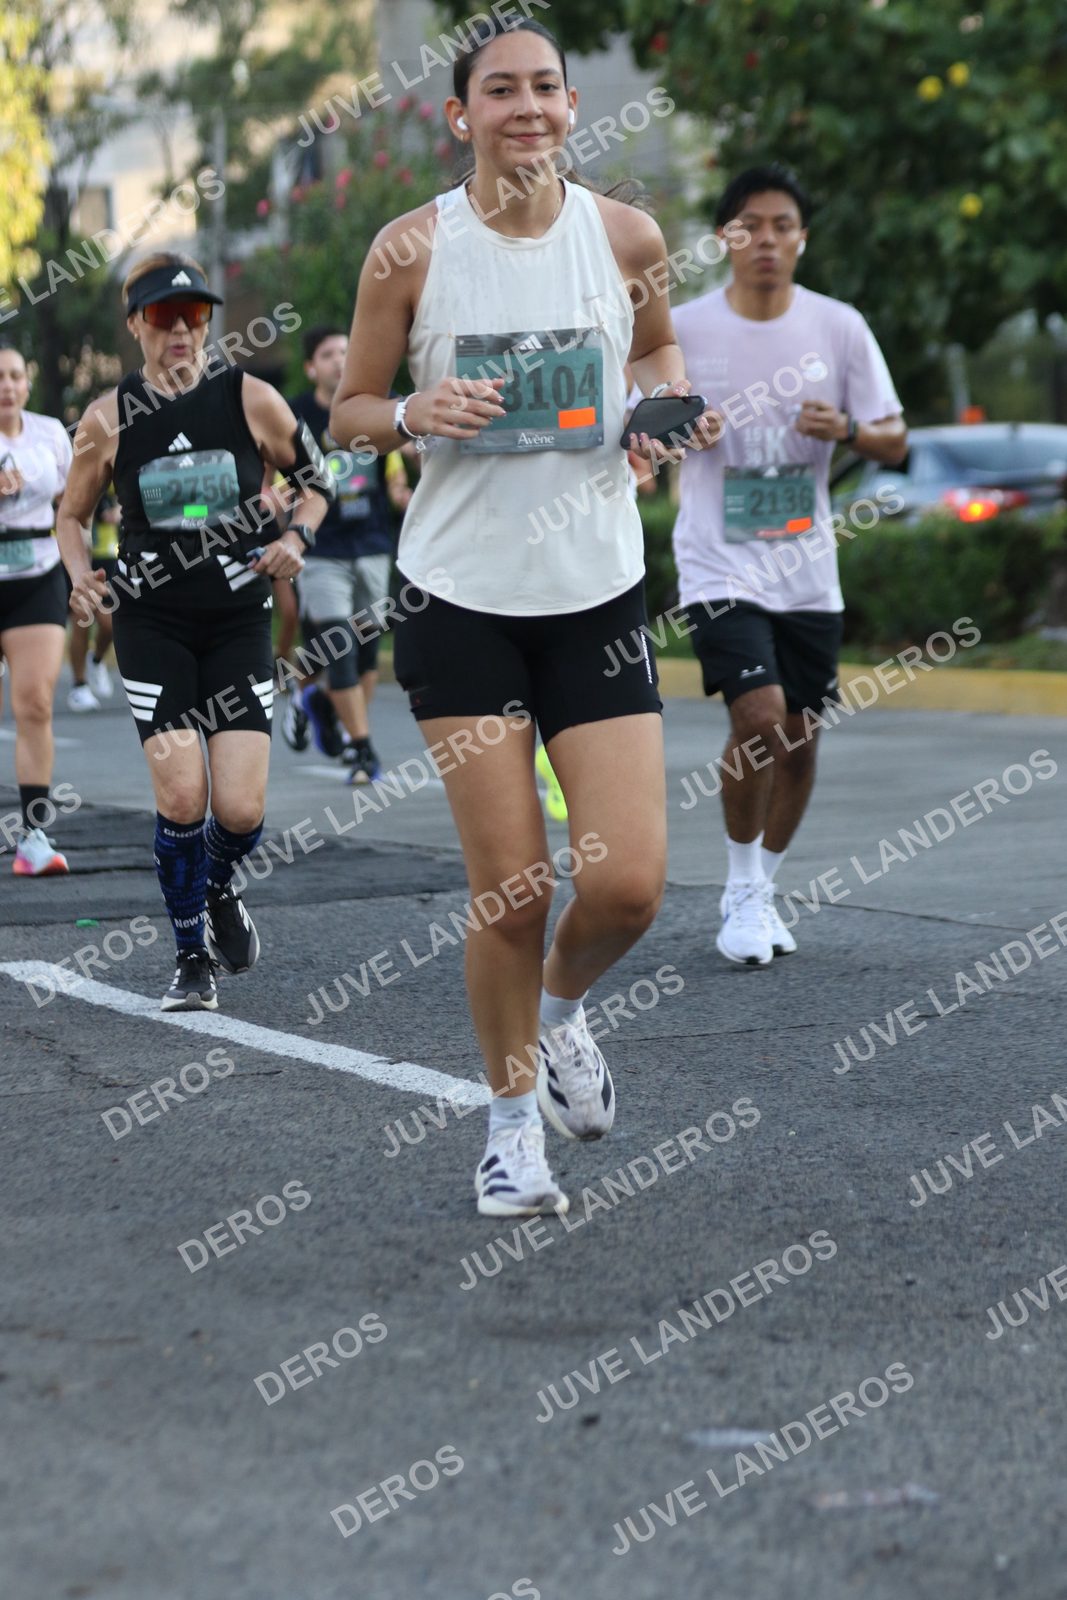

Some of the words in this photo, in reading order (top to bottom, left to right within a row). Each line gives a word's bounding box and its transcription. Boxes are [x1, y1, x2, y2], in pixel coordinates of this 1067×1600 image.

[503, 363, 599, 412] 3104
[517, 432, 555, 445] Avène
[167, 473, 236, 506] 2750
[174, 915, 199, 928] New
